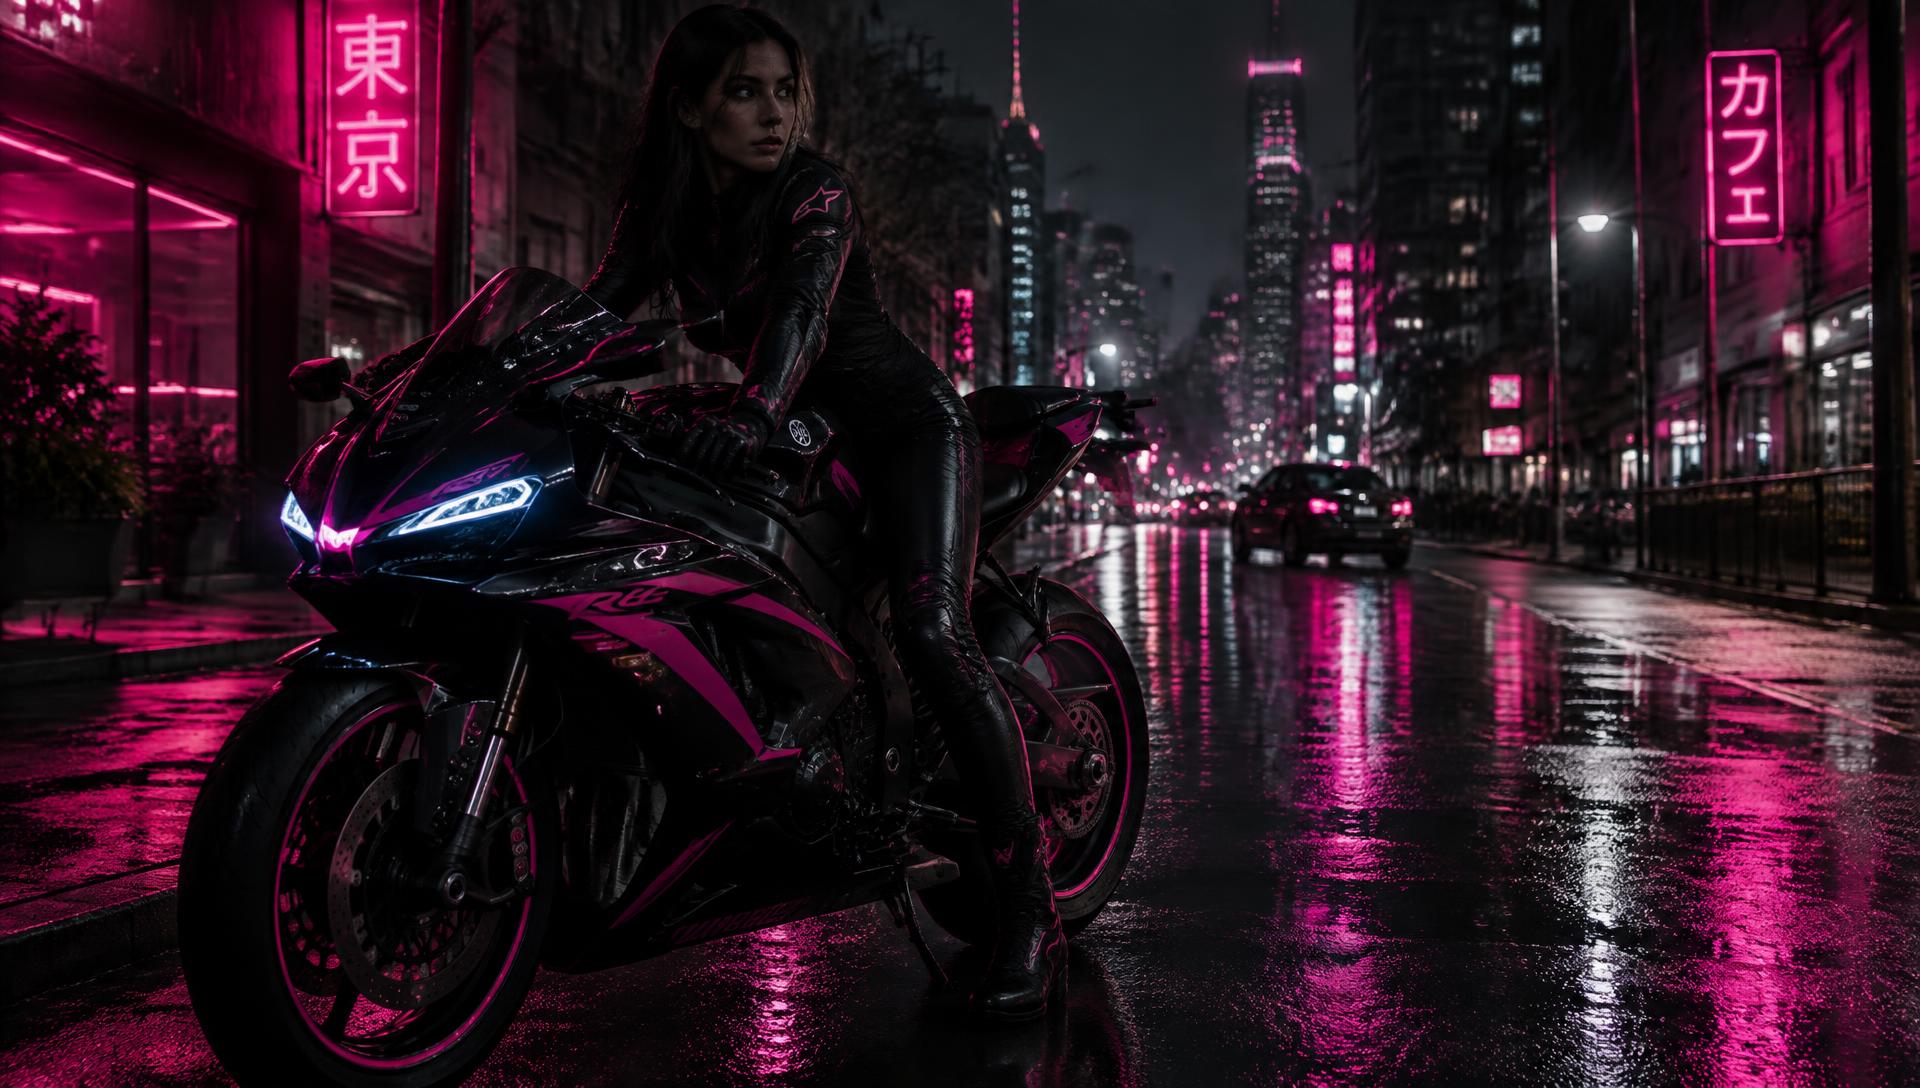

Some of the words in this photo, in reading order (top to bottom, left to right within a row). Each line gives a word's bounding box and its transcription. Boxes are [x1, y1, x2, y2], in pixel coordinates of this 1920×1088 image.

[335, 13, 408, 199] 東京
[1720, 62, 1770, 224] カフェ
